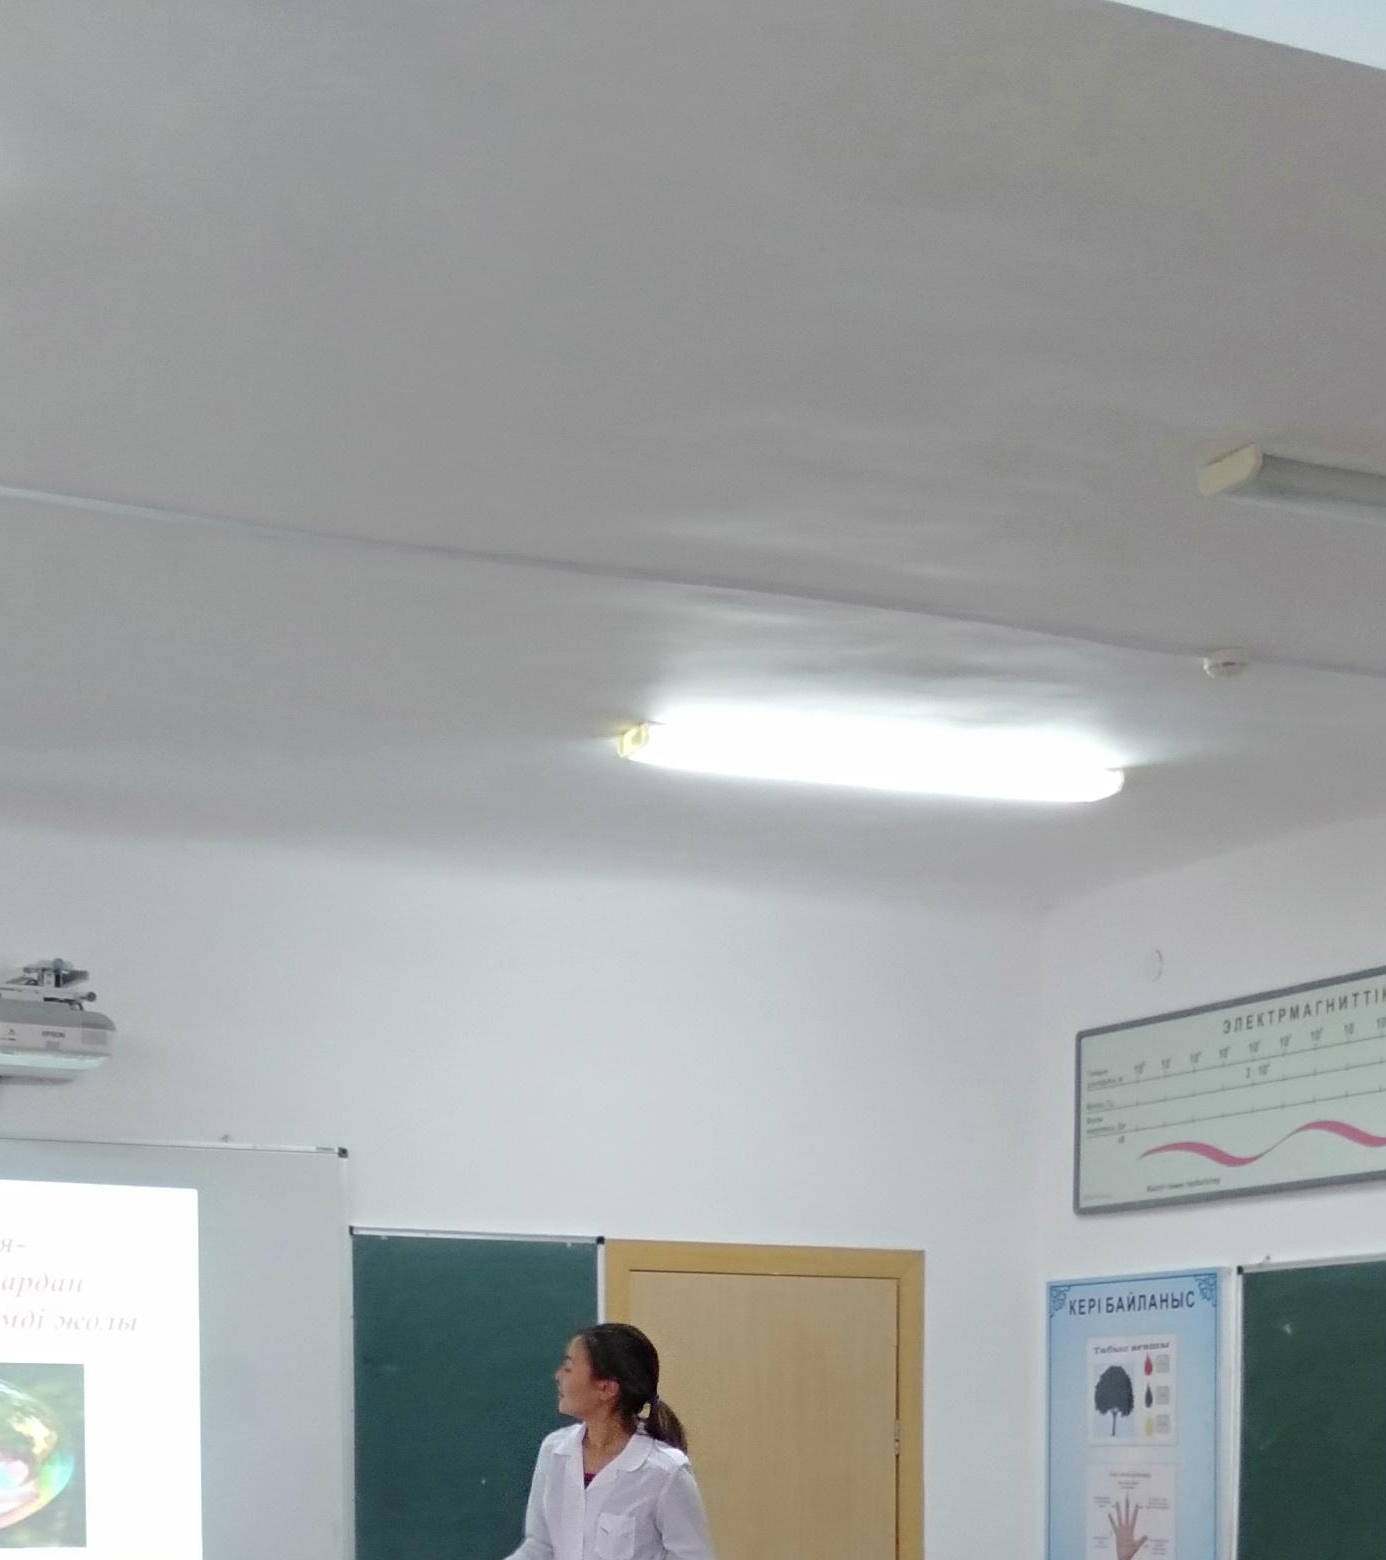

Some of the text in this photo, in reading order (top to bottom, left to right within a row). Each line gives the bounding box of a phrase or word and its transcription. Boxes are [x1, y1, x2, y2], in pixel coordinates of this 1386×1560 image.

[1069, 1290, 1195, 1315] КЕРІ БАЙЛАНЫС
[53, 1312, 140, 1333] жолы
